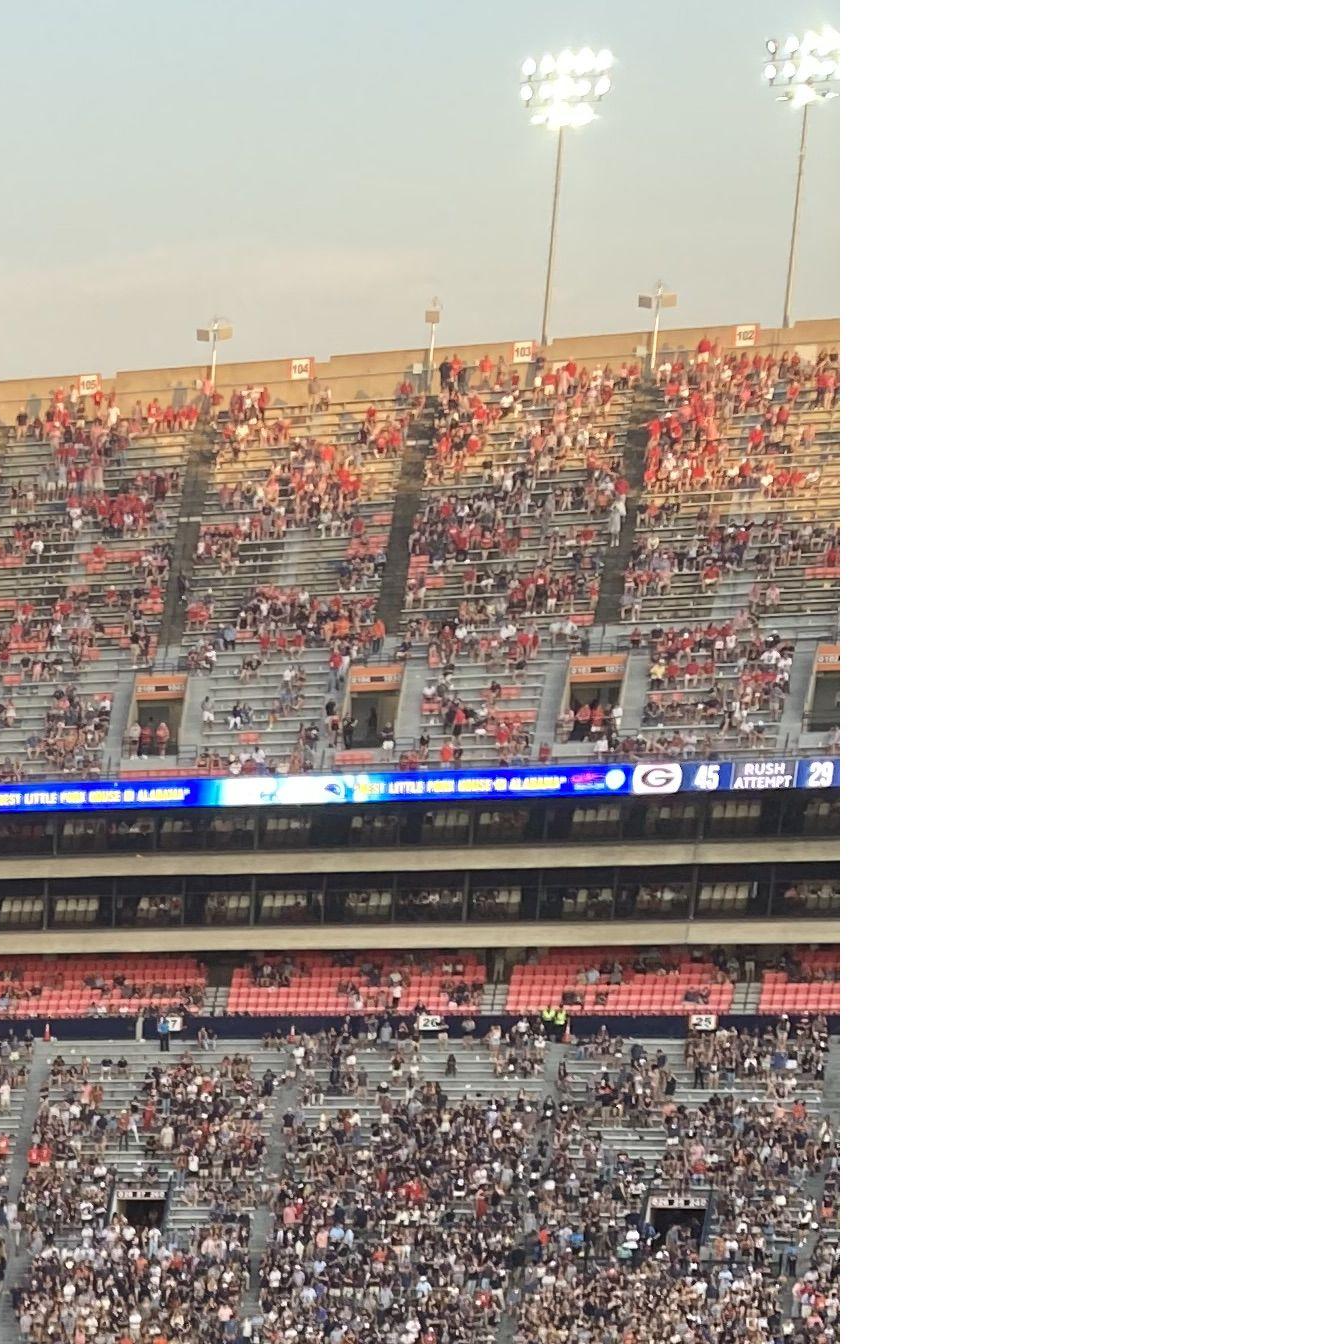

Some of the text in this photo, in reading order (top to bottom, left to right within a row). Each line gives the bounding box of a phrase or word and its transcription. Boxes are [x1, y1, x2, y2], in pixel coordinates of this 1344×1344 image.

[693, 764, 720, 790] 45
[744, 762, 785, 776] RUSH
[808, 761, 834, 788] 29
[733, 775, 793, 790] ATTEMPT
